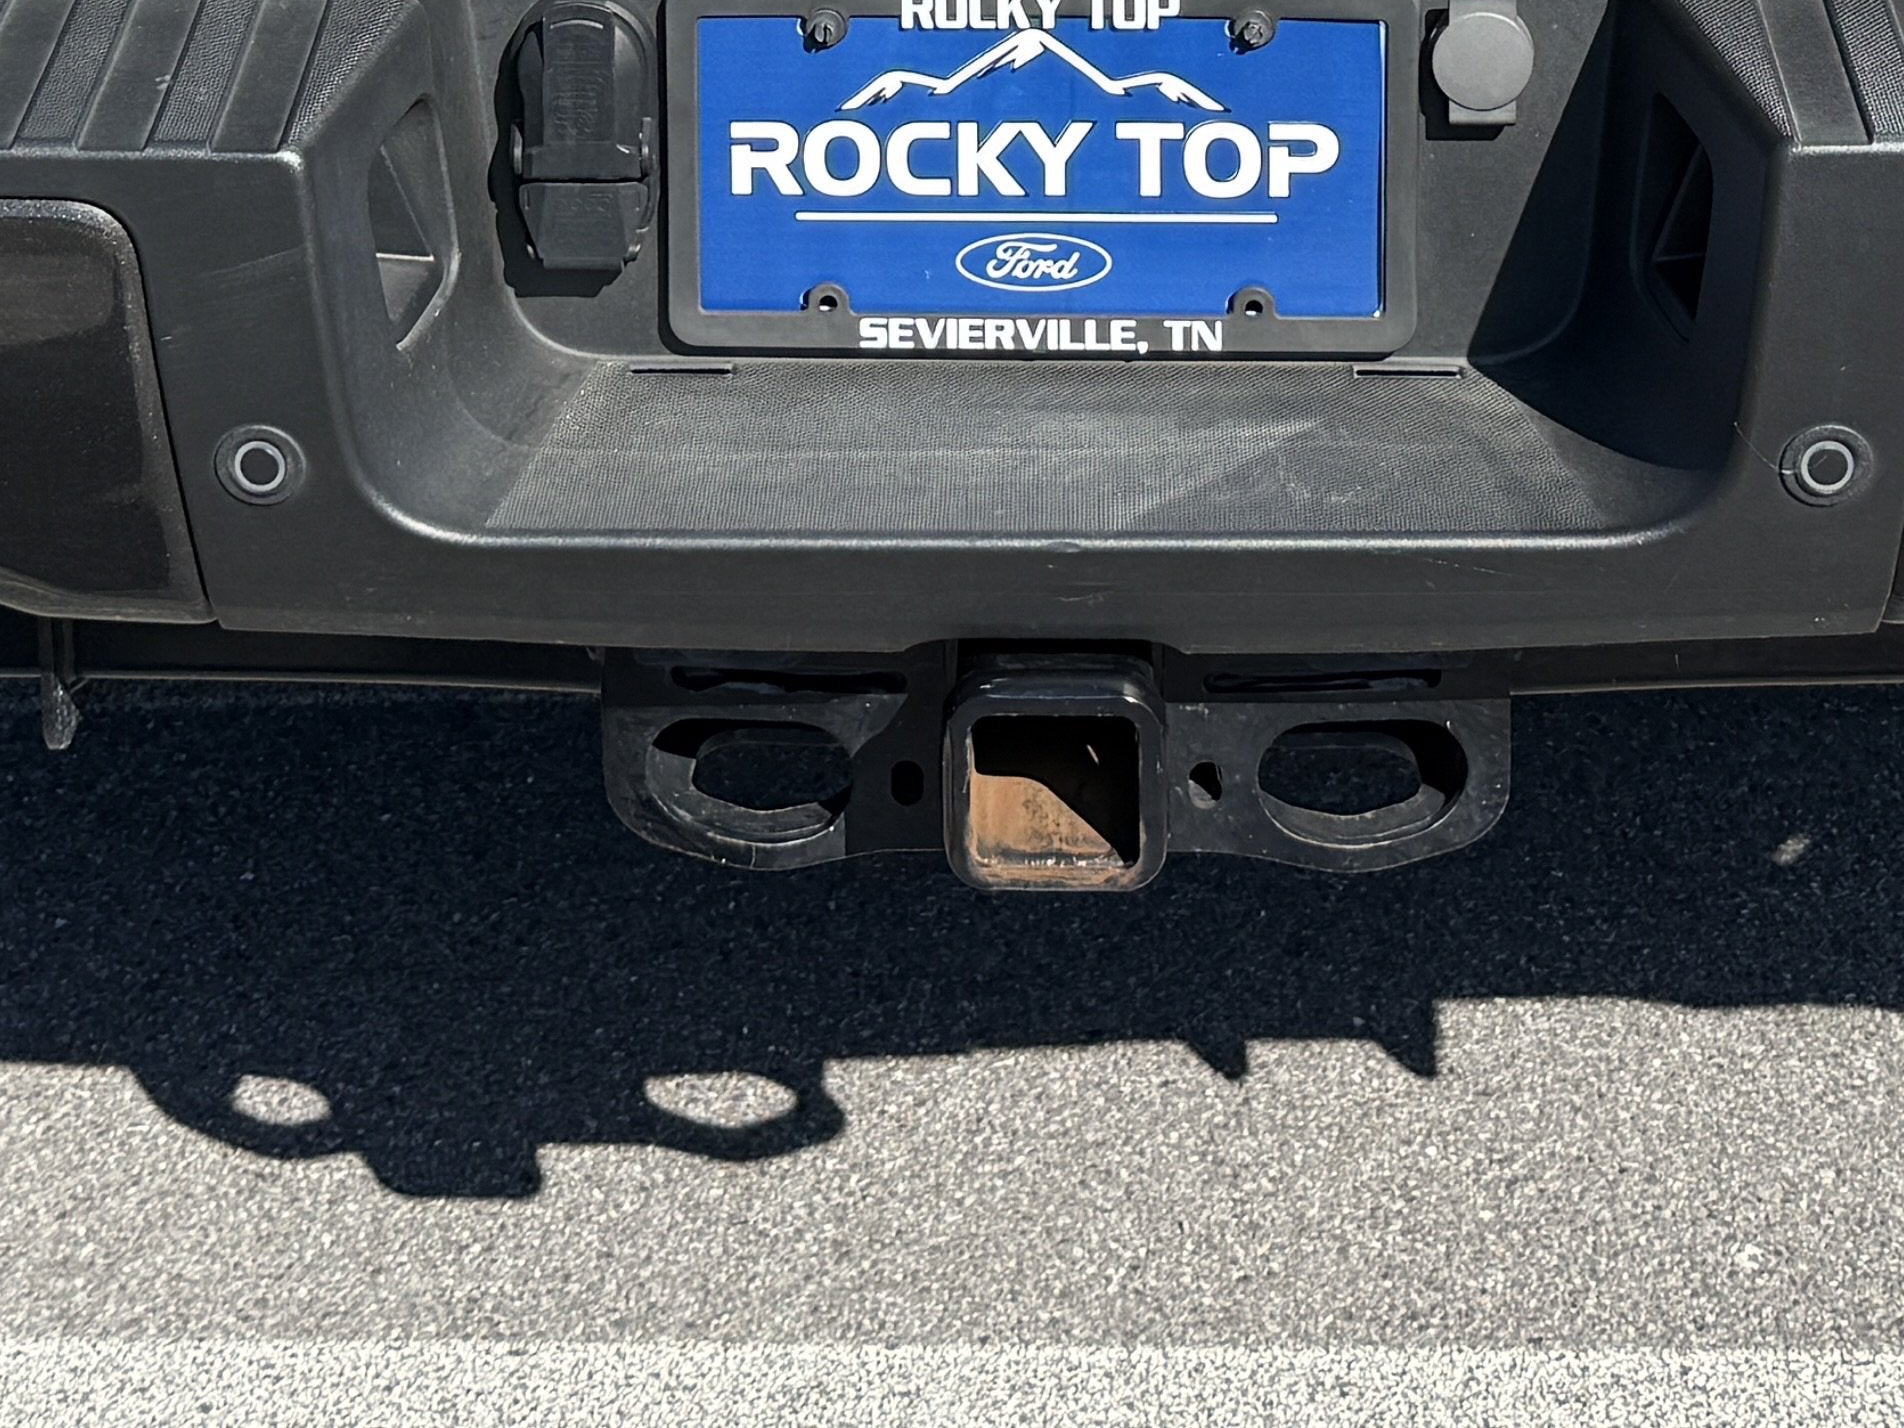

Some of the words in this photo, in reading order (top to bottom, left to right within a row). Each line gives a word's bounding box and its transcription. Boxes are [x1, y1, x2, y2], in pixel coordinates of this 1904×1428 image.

[728, 120, 1094, 198] ROCKY
[1114, 120, 1341, 199] TOP
[986, 241, 1080, 280] Ford
[858, 317, 1149, 355] SEVIERVILLE,
[1162, 319, 1223, 352] TN
